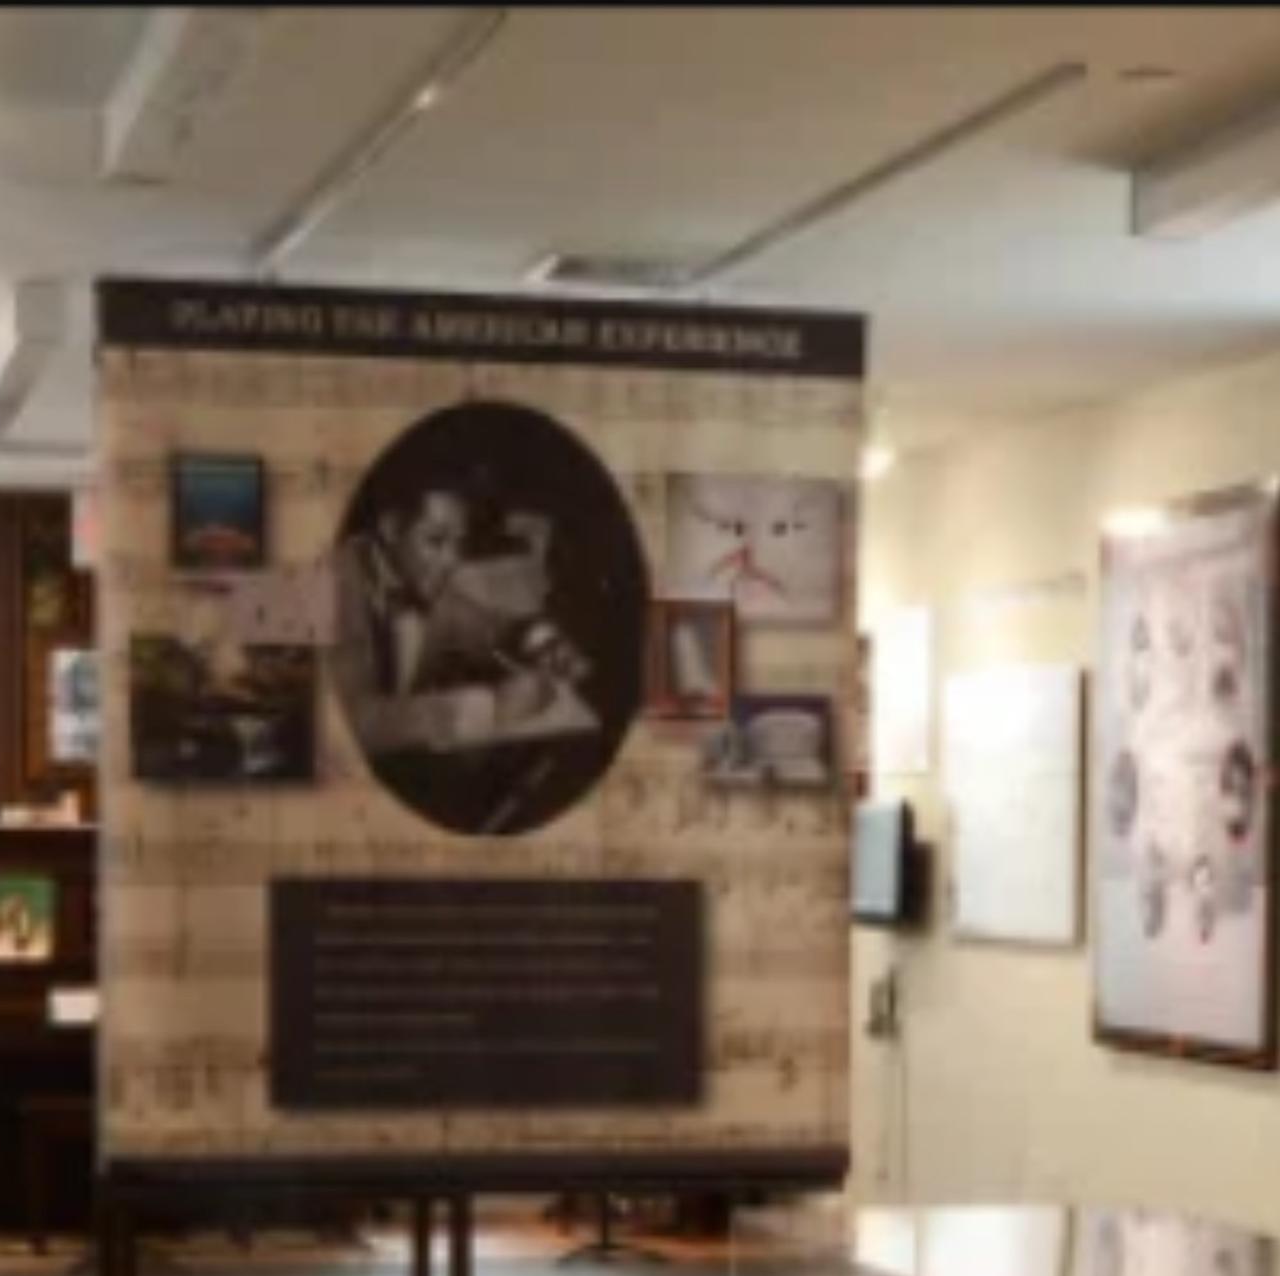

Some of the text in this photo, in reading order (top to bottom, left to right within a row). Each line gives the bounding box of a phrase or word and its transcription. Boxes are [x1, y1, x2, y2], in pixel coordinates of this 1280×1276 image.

[332, 305, 393, 336] THE
[410, 308, 589, 347] AMERICAN
[598, 318, 804, 358] EXPERIENCE
